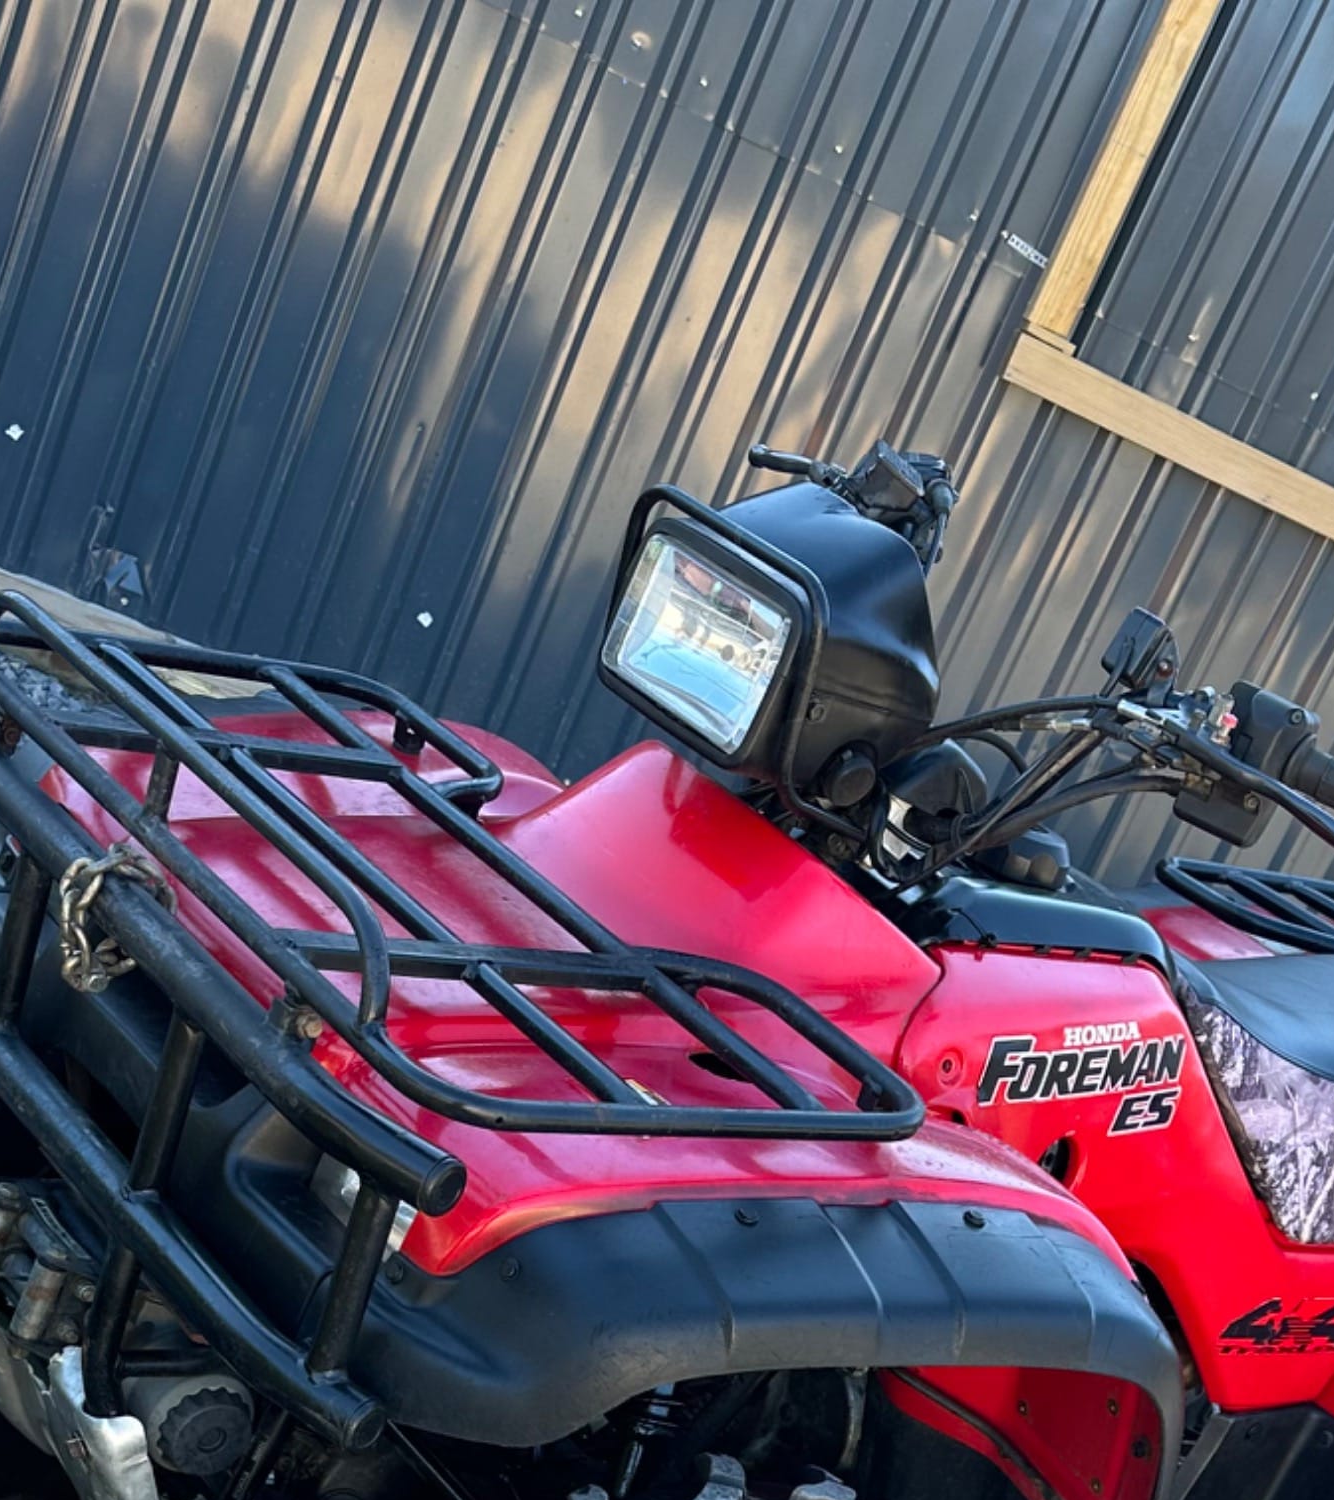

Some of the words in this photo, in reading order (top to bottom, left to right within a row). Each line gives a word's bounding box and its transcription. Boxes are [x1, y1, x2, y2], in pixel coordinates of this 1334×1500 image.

[1063, 1021, 1141, 1047] HONDA
[976, 1034, 1187, 1107] FOREMAN
[1107, 1086, 1183, 1137] ES
